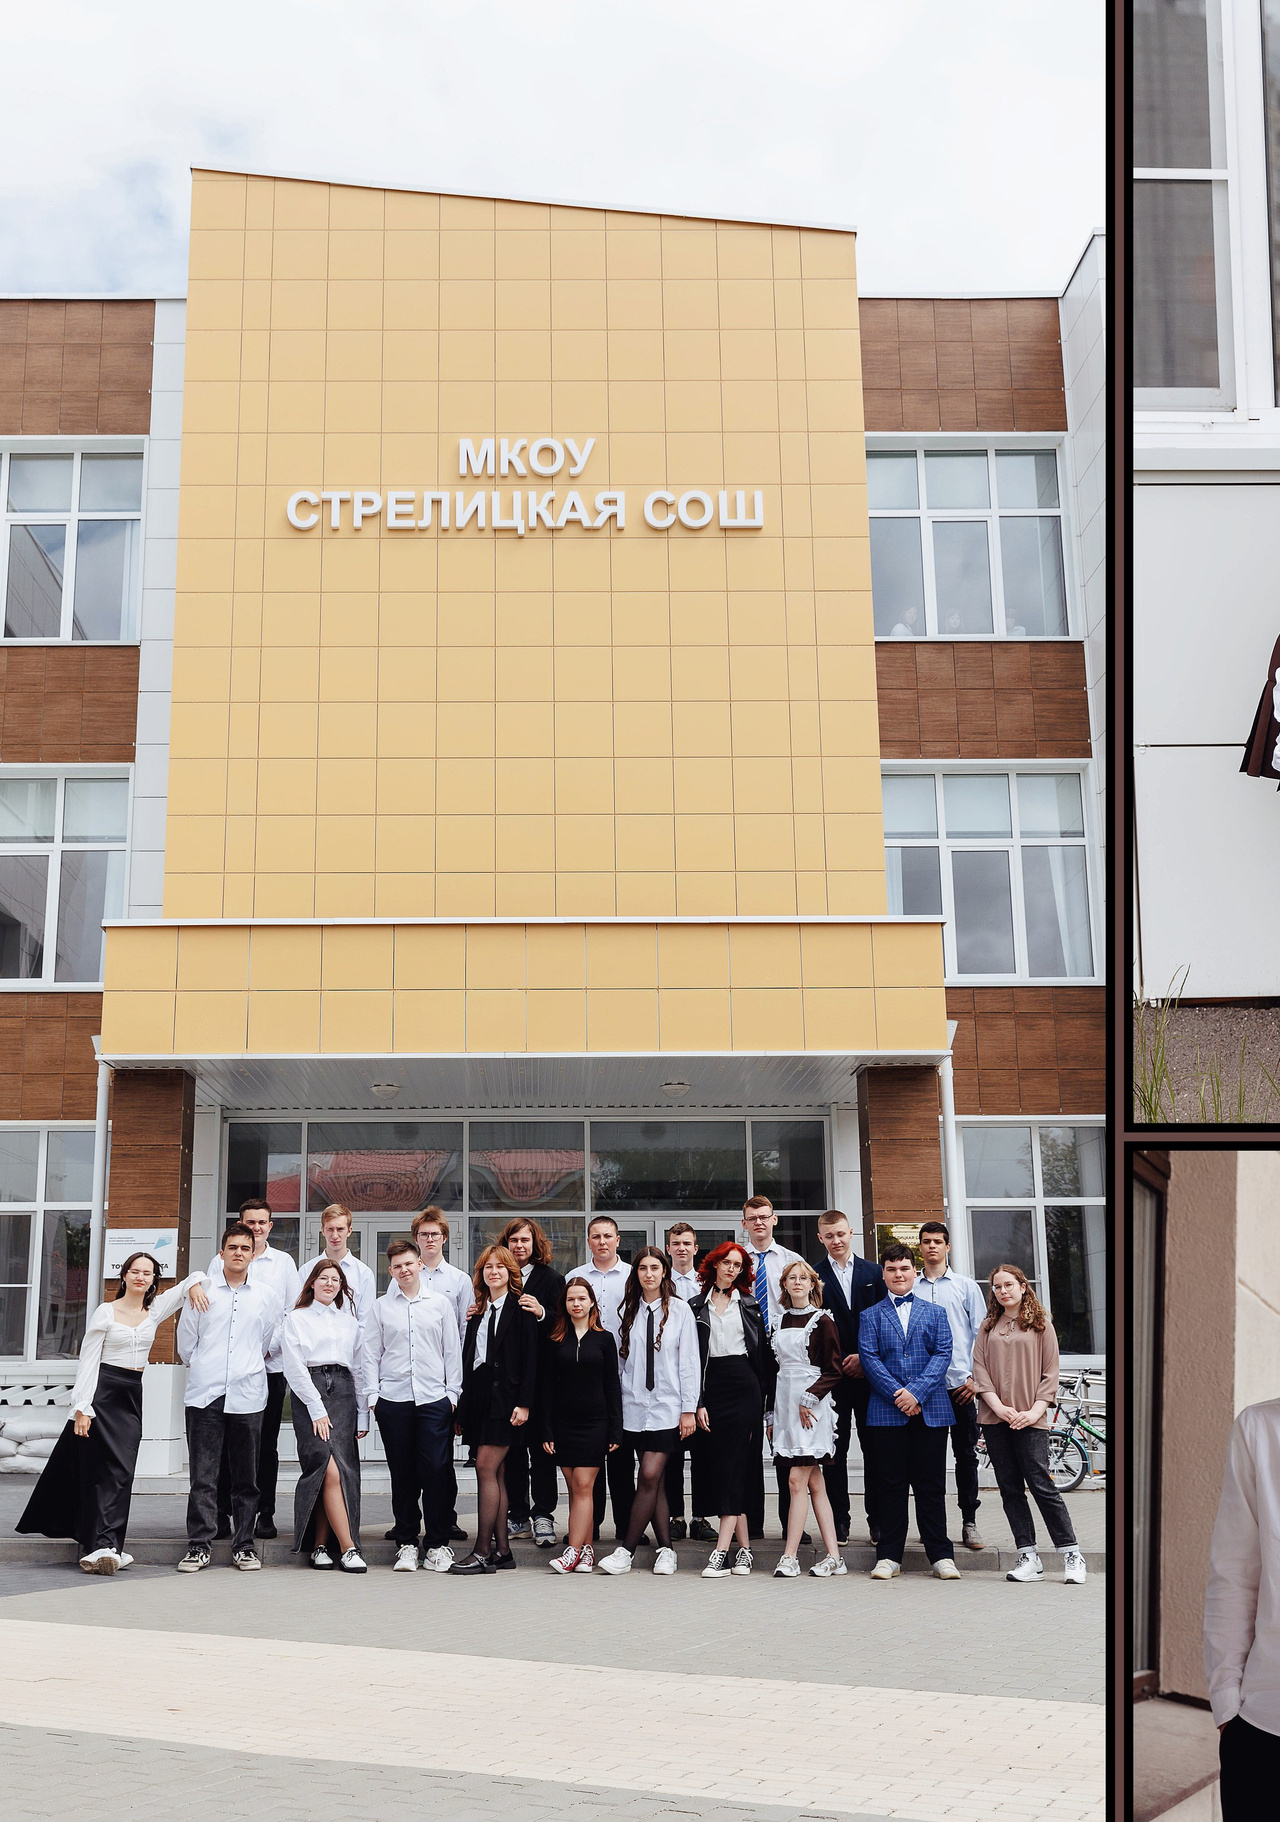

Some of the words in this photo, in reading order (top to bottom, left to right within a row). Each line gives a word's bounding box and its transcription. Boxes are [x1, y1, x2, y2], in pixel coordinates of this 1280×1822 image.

[458, 437, 597, 477] МКОУ
[286, 490, 626, 537] СТРЕЛИЦКАЯ
[643, 489, 764, 530] СОШ
